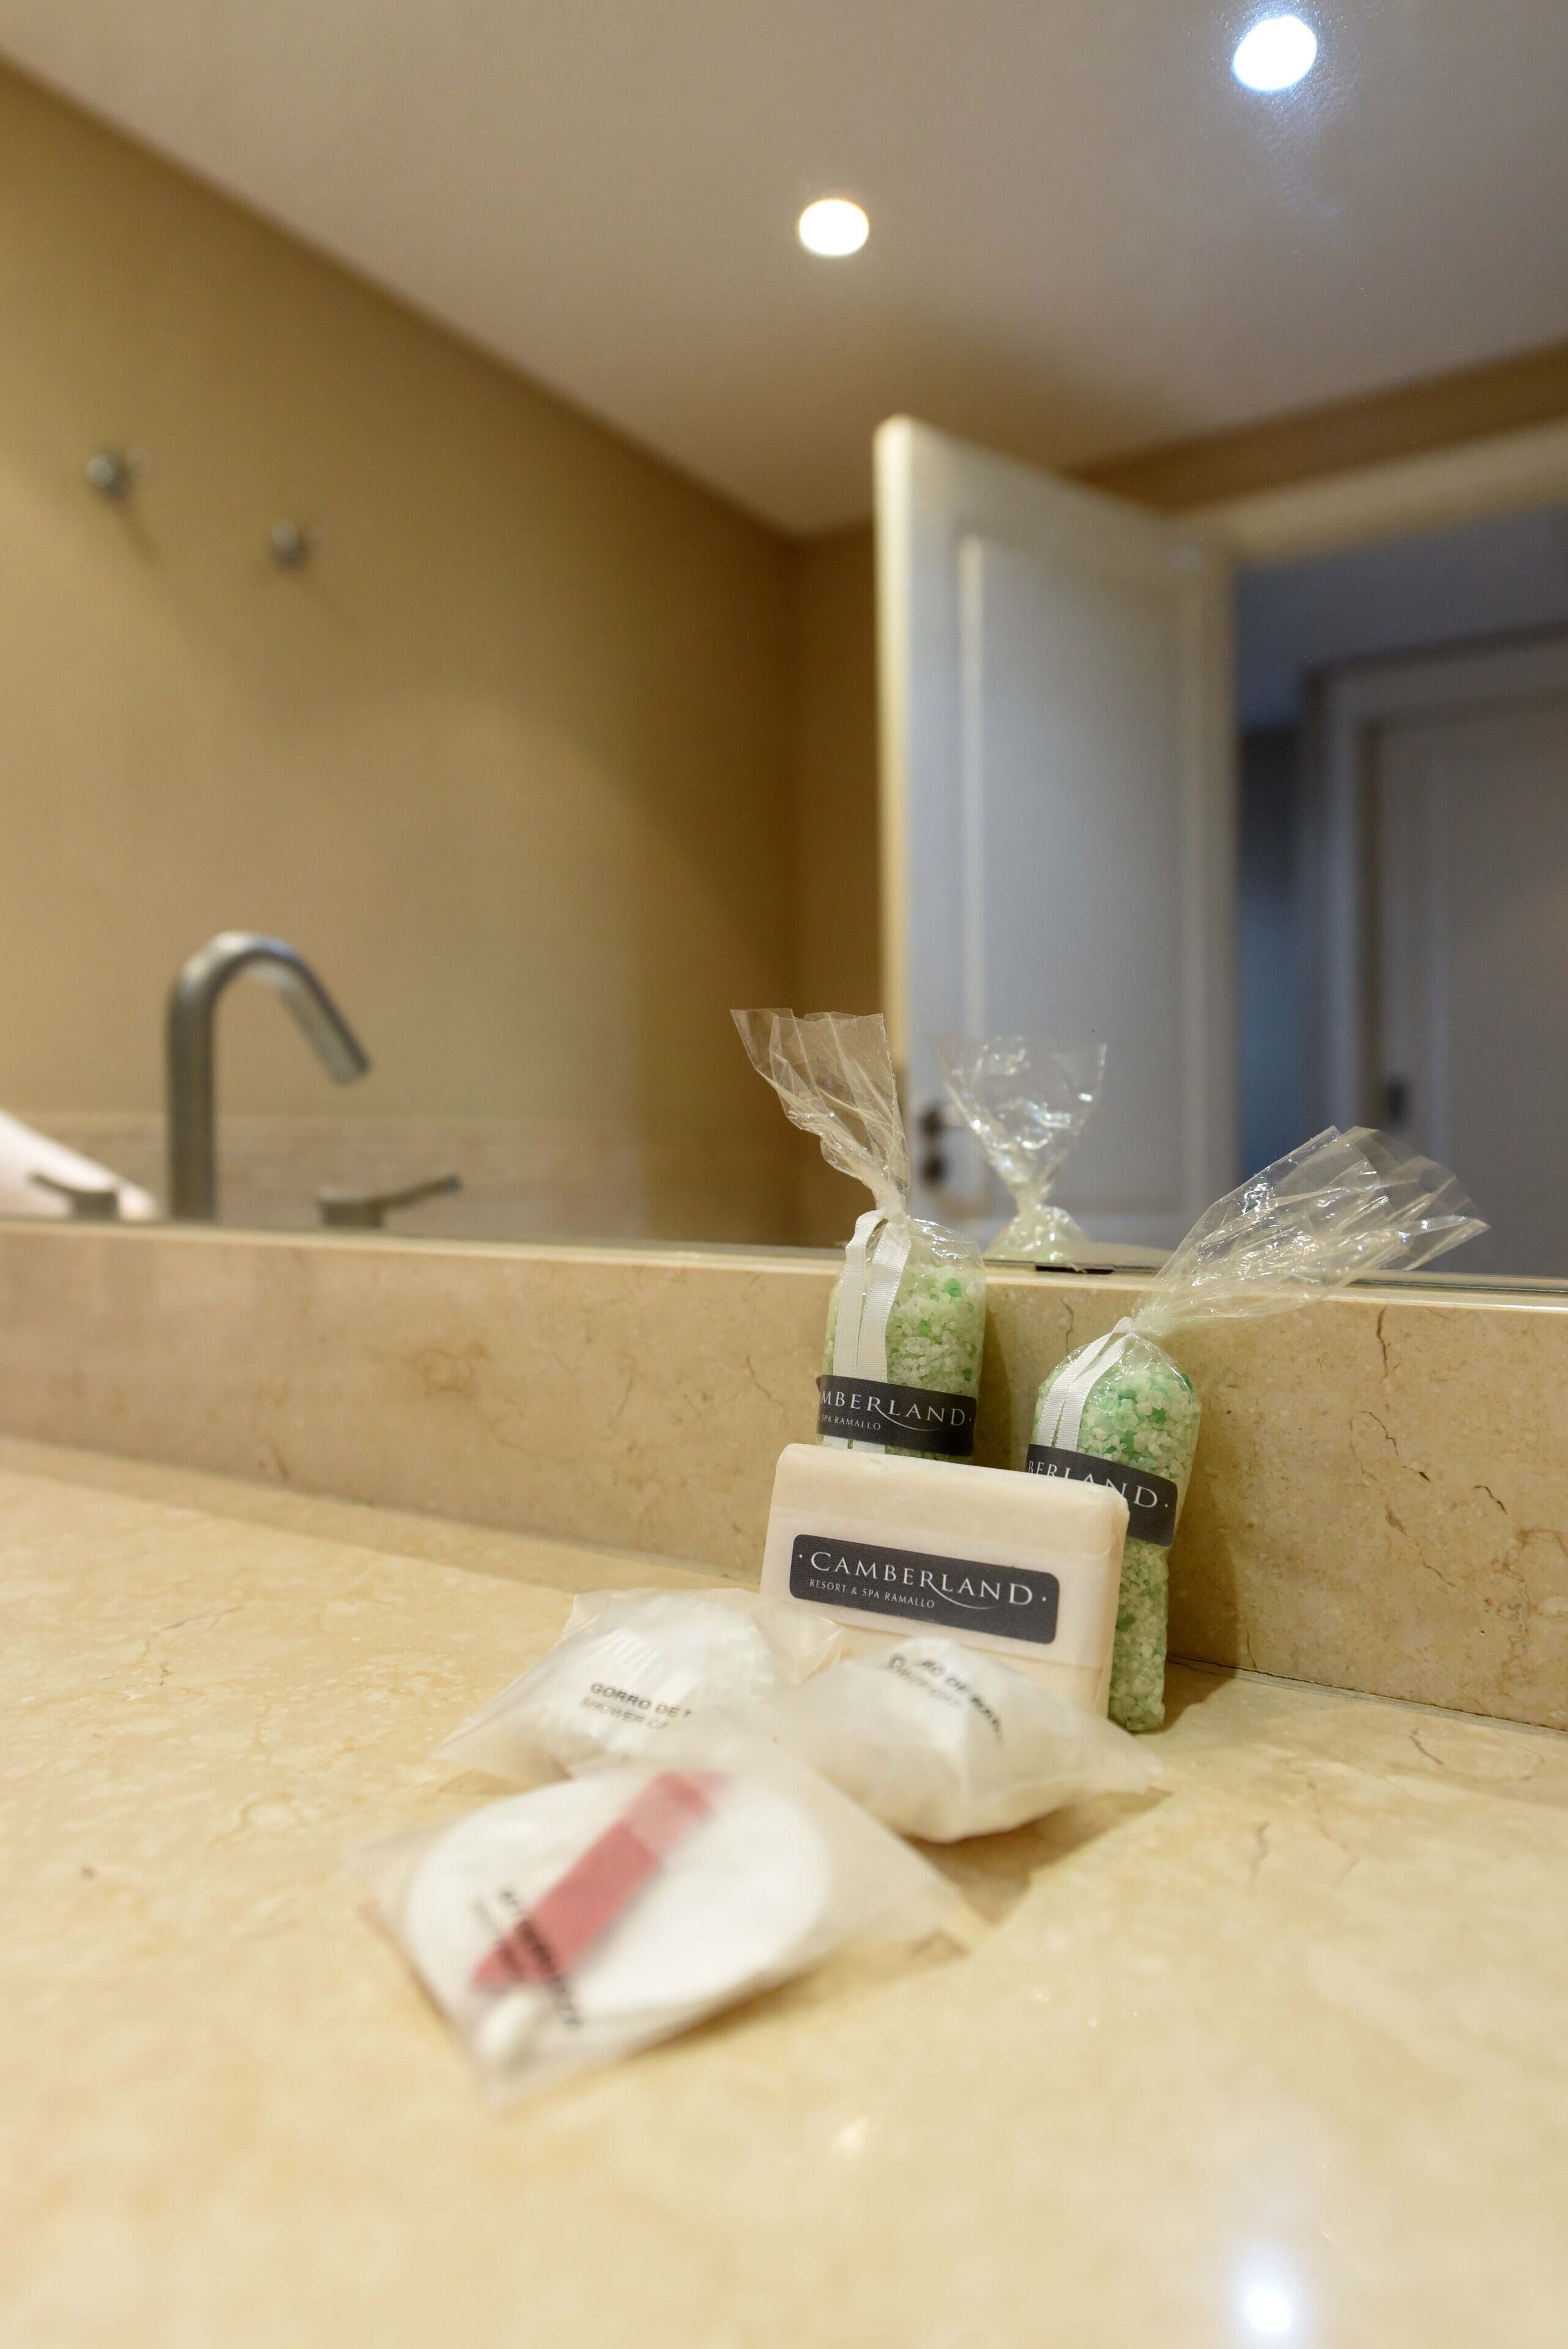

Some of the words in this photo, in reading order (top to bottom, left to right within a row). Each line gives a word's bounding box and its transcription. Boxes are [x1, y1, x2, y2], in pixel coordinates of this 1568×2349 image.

[834, 1416, 881, 1430] RAMALLO
[809, 1579, 847, 1593] RESORT
[862, 1588, 880, 1599] SPA
[885, 1592, 935, 1609] RAMALLO
[811, 1551, 1033, 1609] CAMBERLAND
[591, 1682, 652, 1710] GORRO
[655, 1703, 681, 1718] DE
